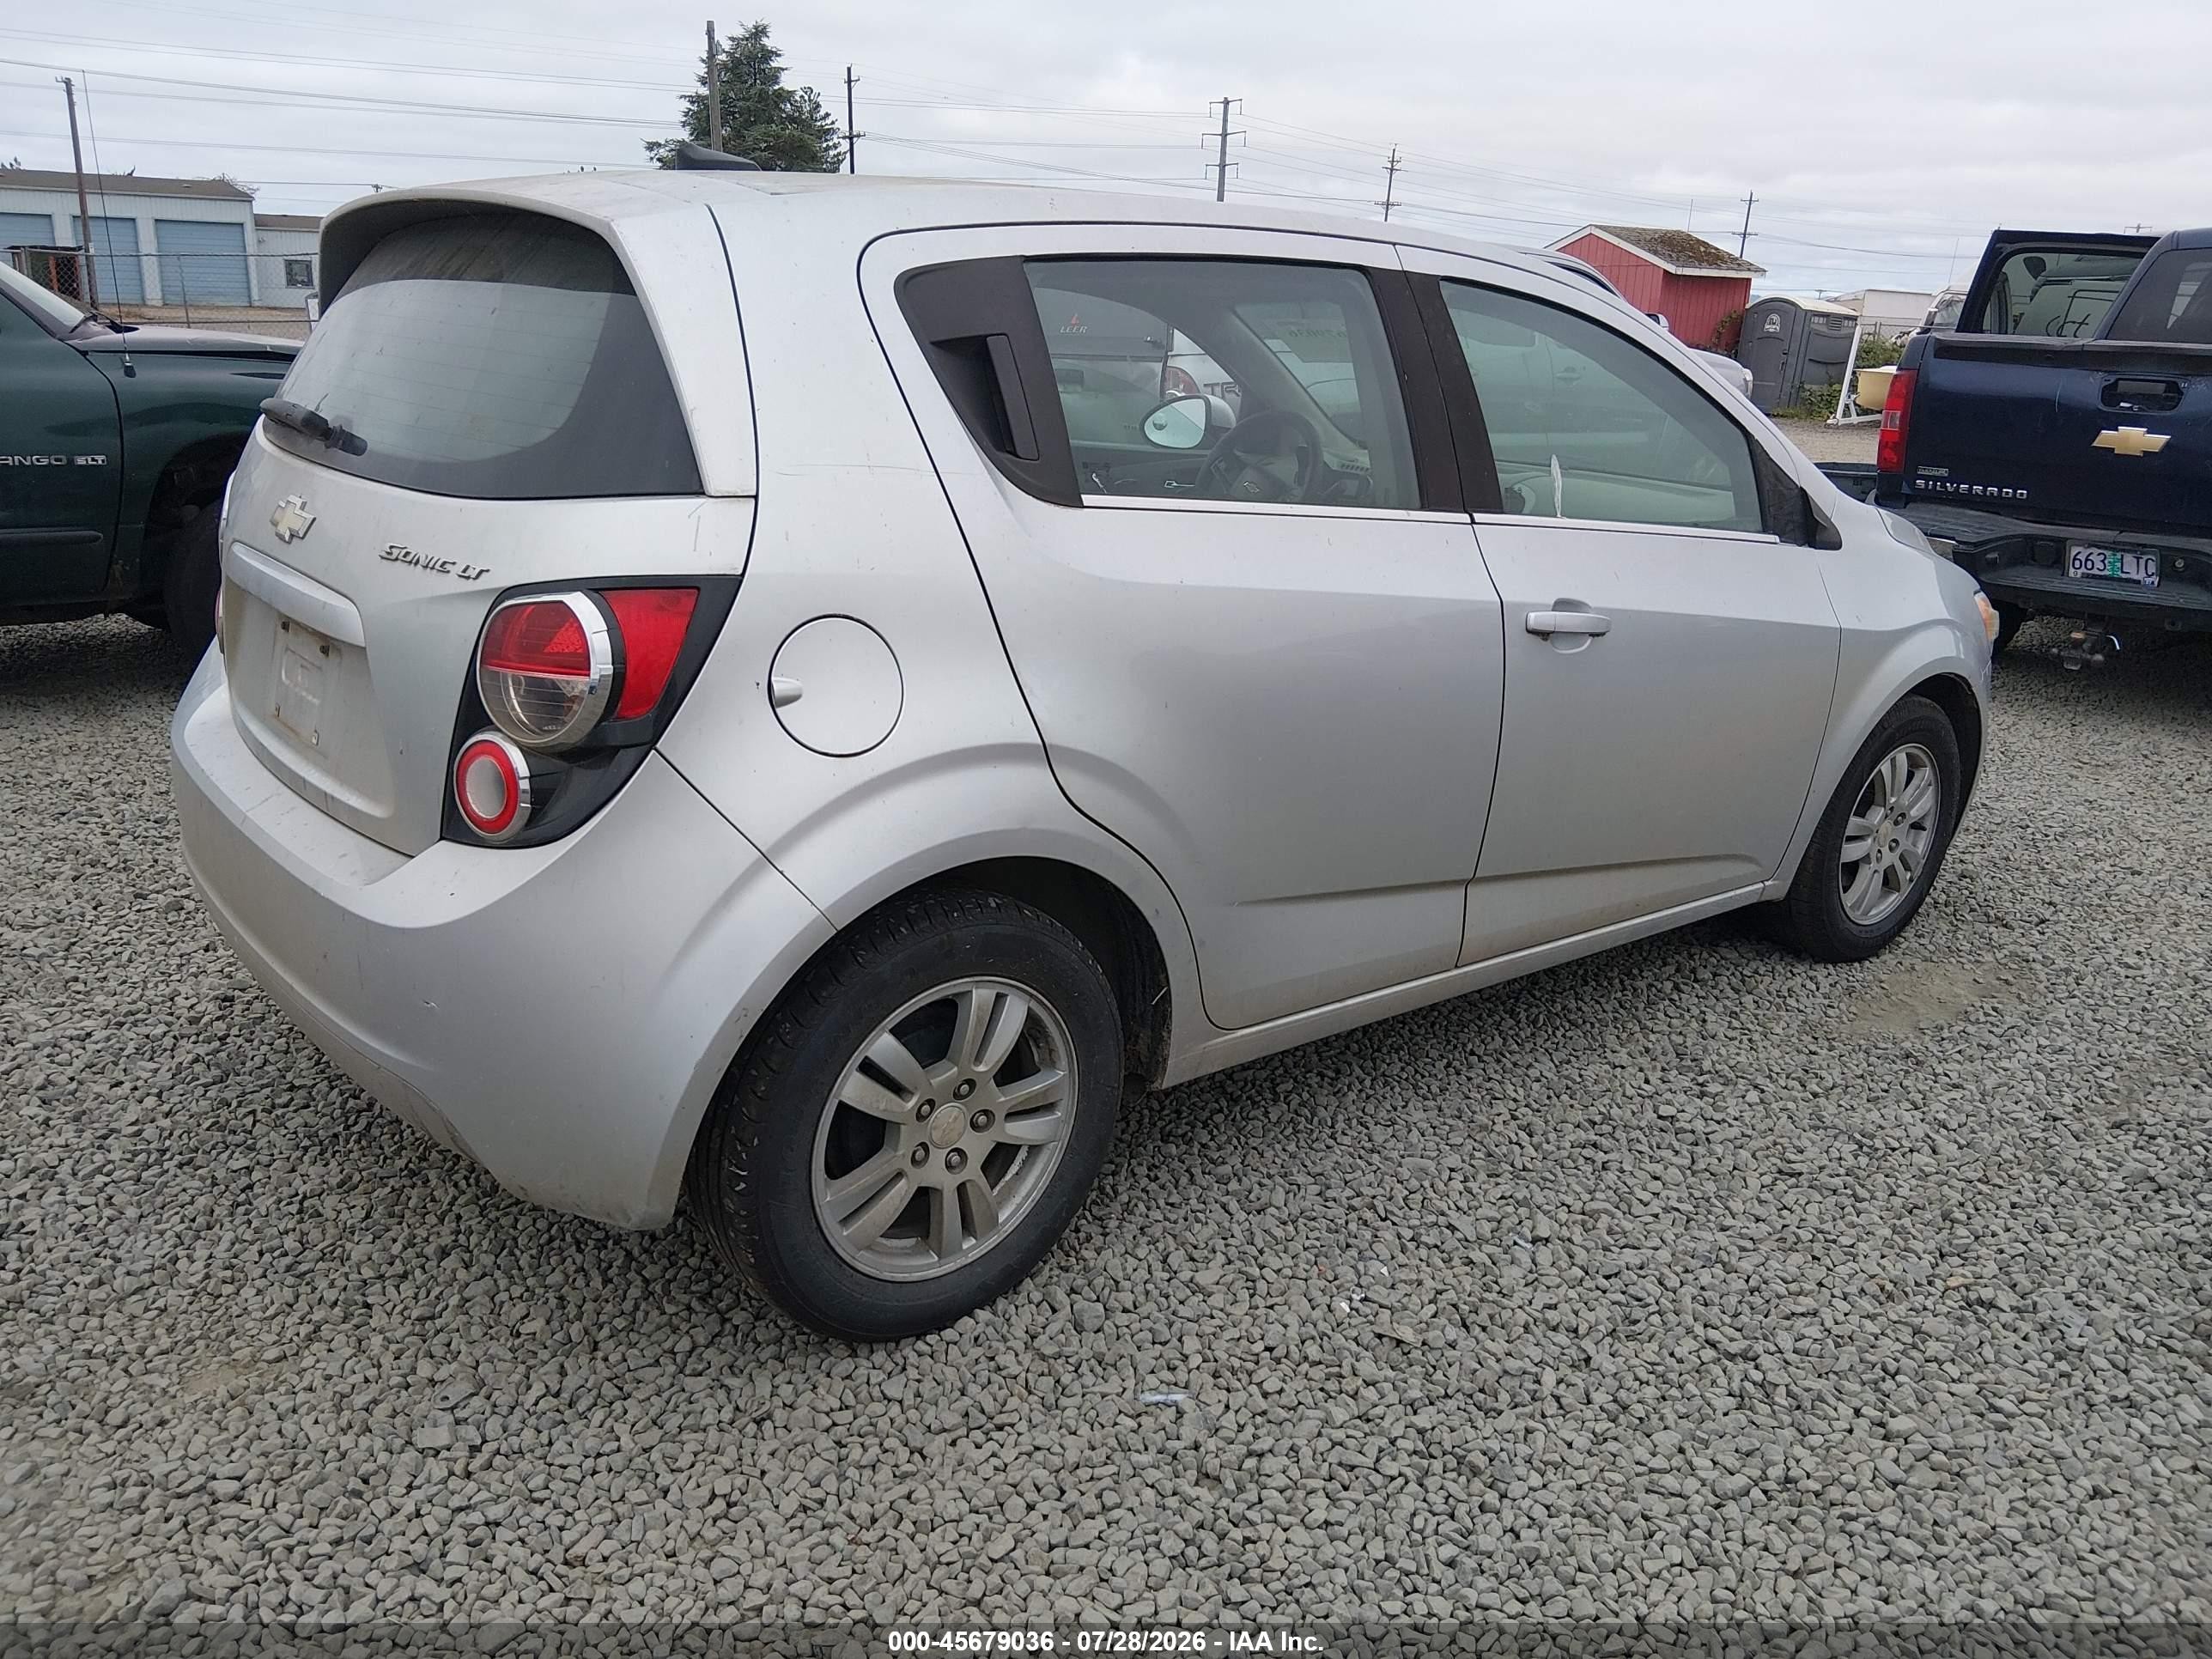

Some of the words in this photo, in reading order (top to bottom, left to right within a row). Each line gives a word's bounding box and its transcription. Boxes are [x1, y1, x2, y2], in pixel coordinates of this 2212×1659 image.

[75, 455, 106, 465] SLT
[1915, 480, 2027, 500] SILVERADO
[456, 564, 490, 580] LT
[2072, 550, 2107, 572] 663
[2120, 554, 2155, 577] LTC
